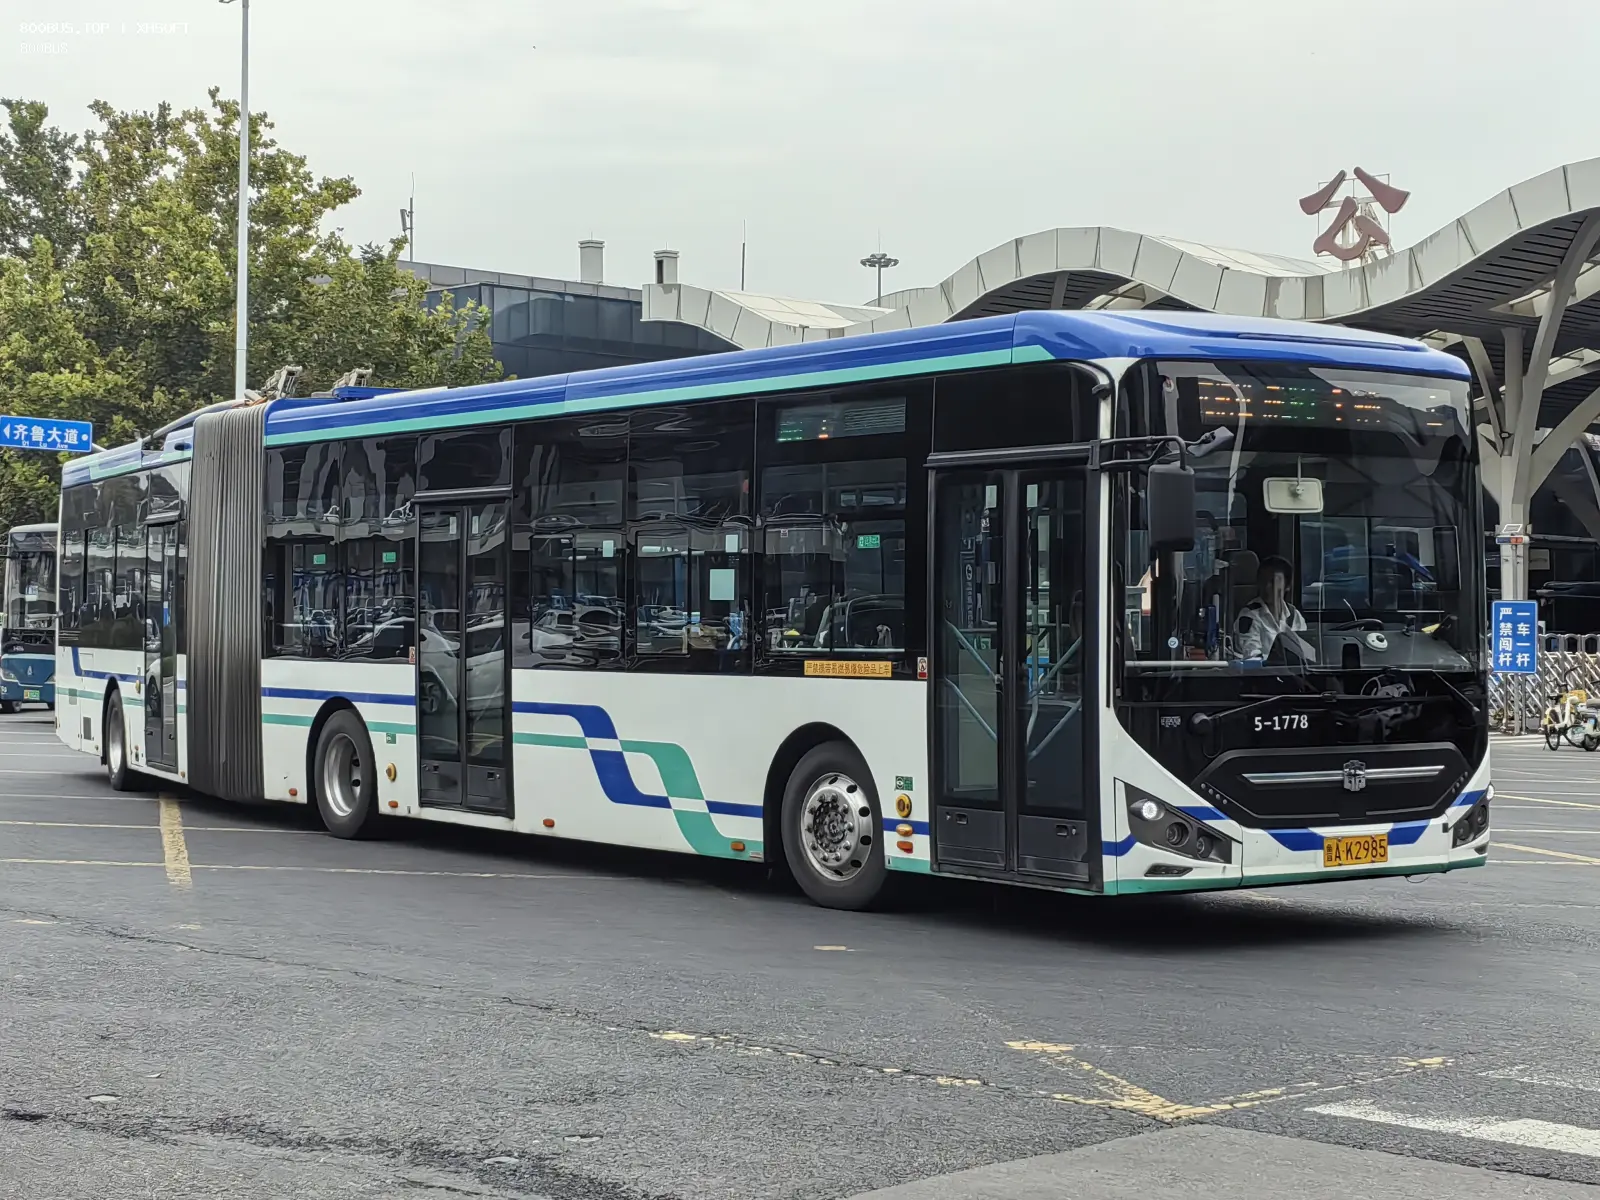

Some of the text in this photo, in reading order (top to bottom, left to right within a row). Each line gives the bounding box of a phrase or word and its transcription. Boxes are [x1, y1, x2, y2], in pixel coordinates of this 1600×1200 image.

[1299, 166, 1411, 261] 公
[13, 423, 79, 445] 齐鲁大道
[1498, 607, 1513, 667] 严禁闯杆
[1516, 612, 1531, 667] 一车一杆
[1254, 714, 1309, 732] 5-1778
